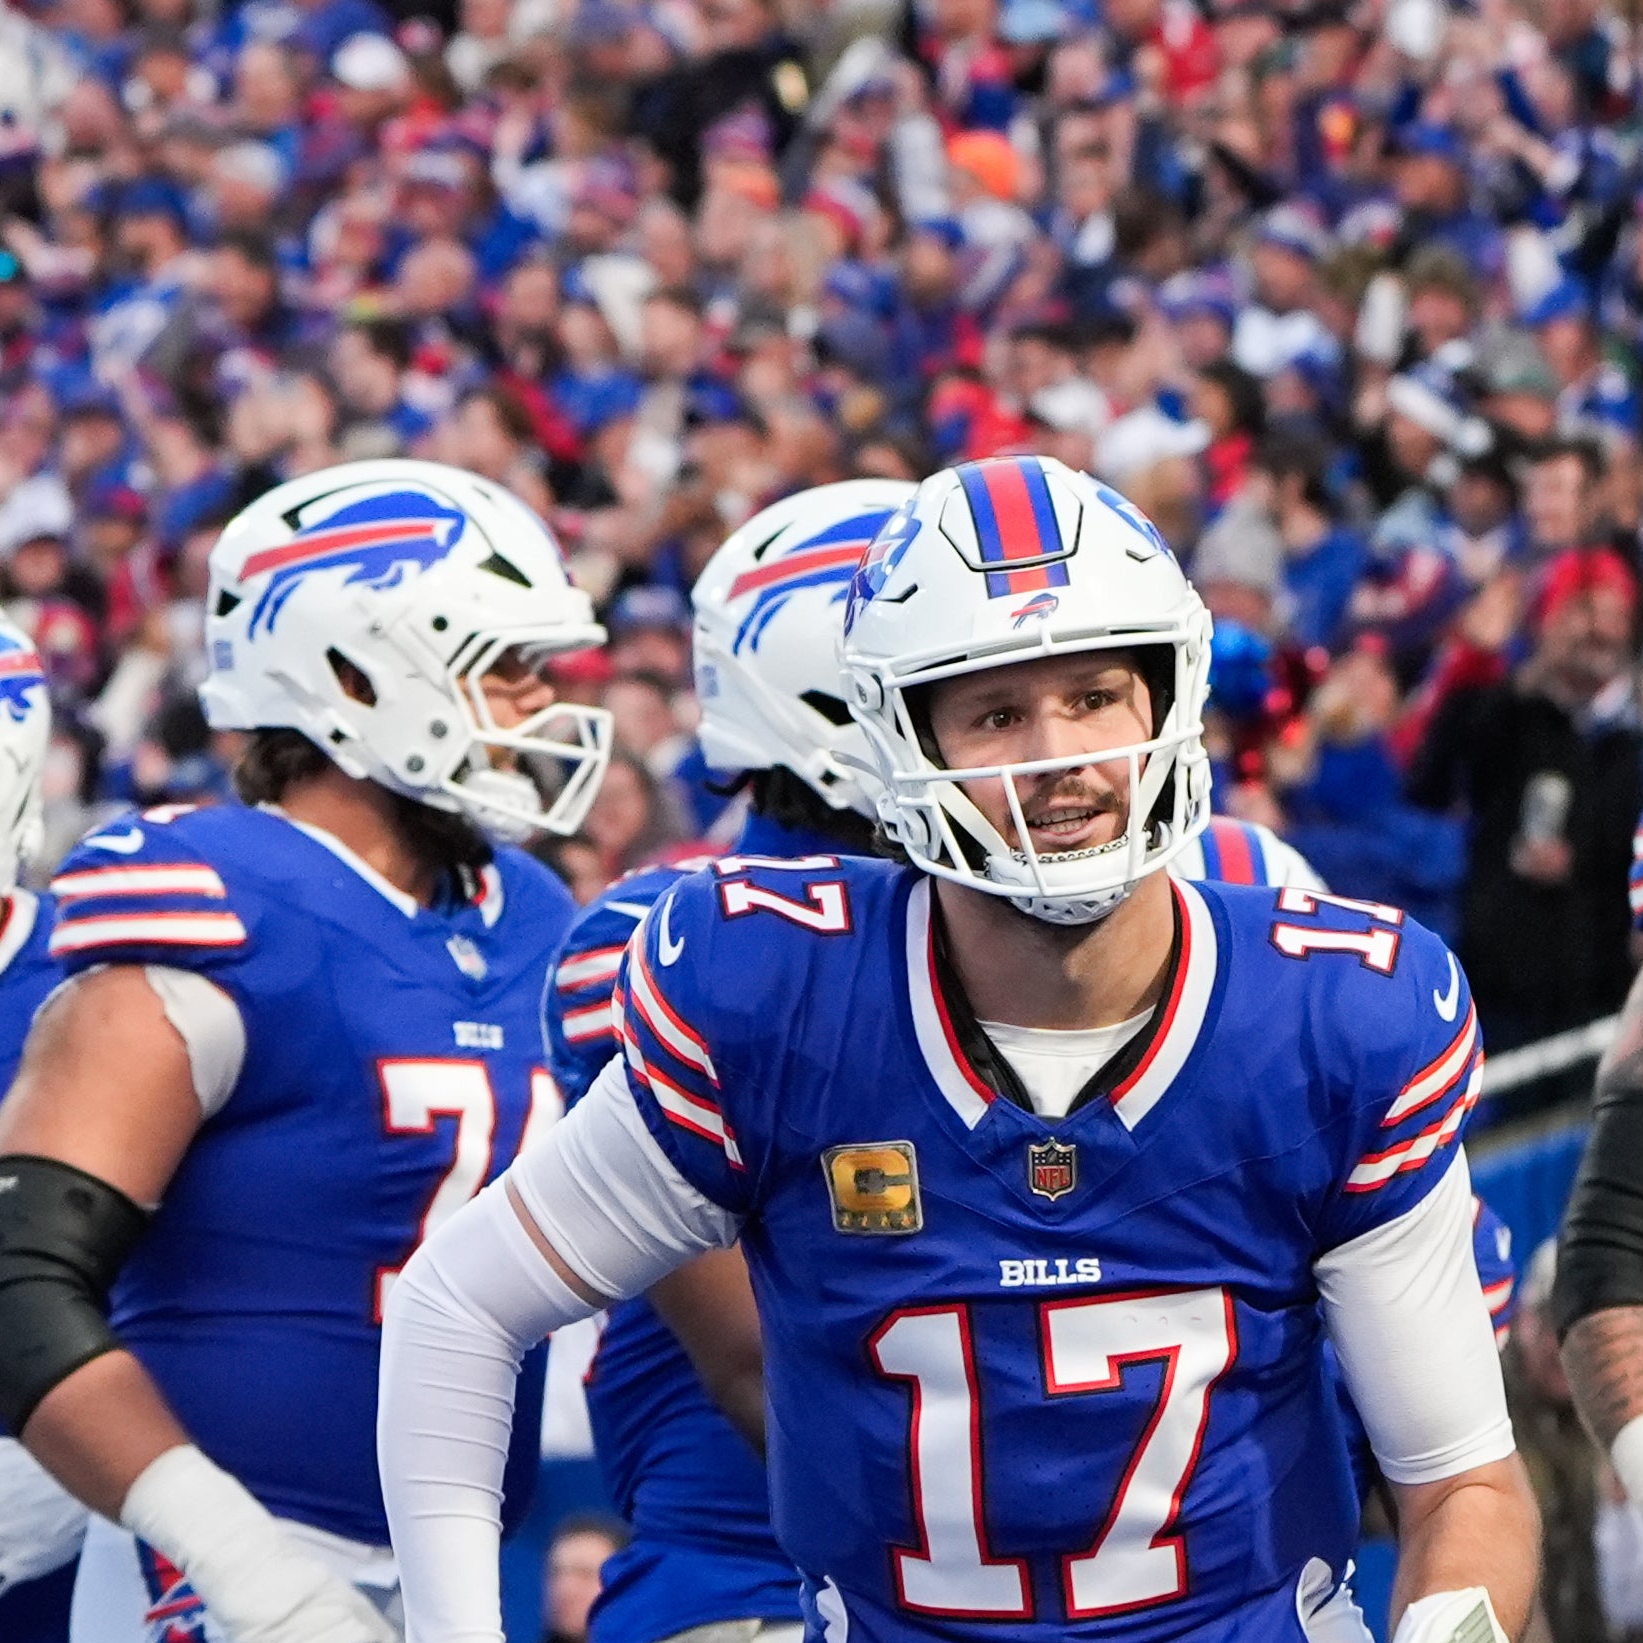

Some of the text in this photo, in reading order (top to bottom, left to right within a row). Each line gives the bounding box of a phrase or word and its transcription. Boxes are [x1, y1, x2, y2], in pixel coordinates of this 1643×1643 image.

[375, 1057, 564, 1325] 7
[831, 1149, 912, 1213] C
[1036, 1167, 1070, 1190] NFL
[999, 1258, 1102, 1287] BILLS
[865, 1286, 1239, 1620] 17
